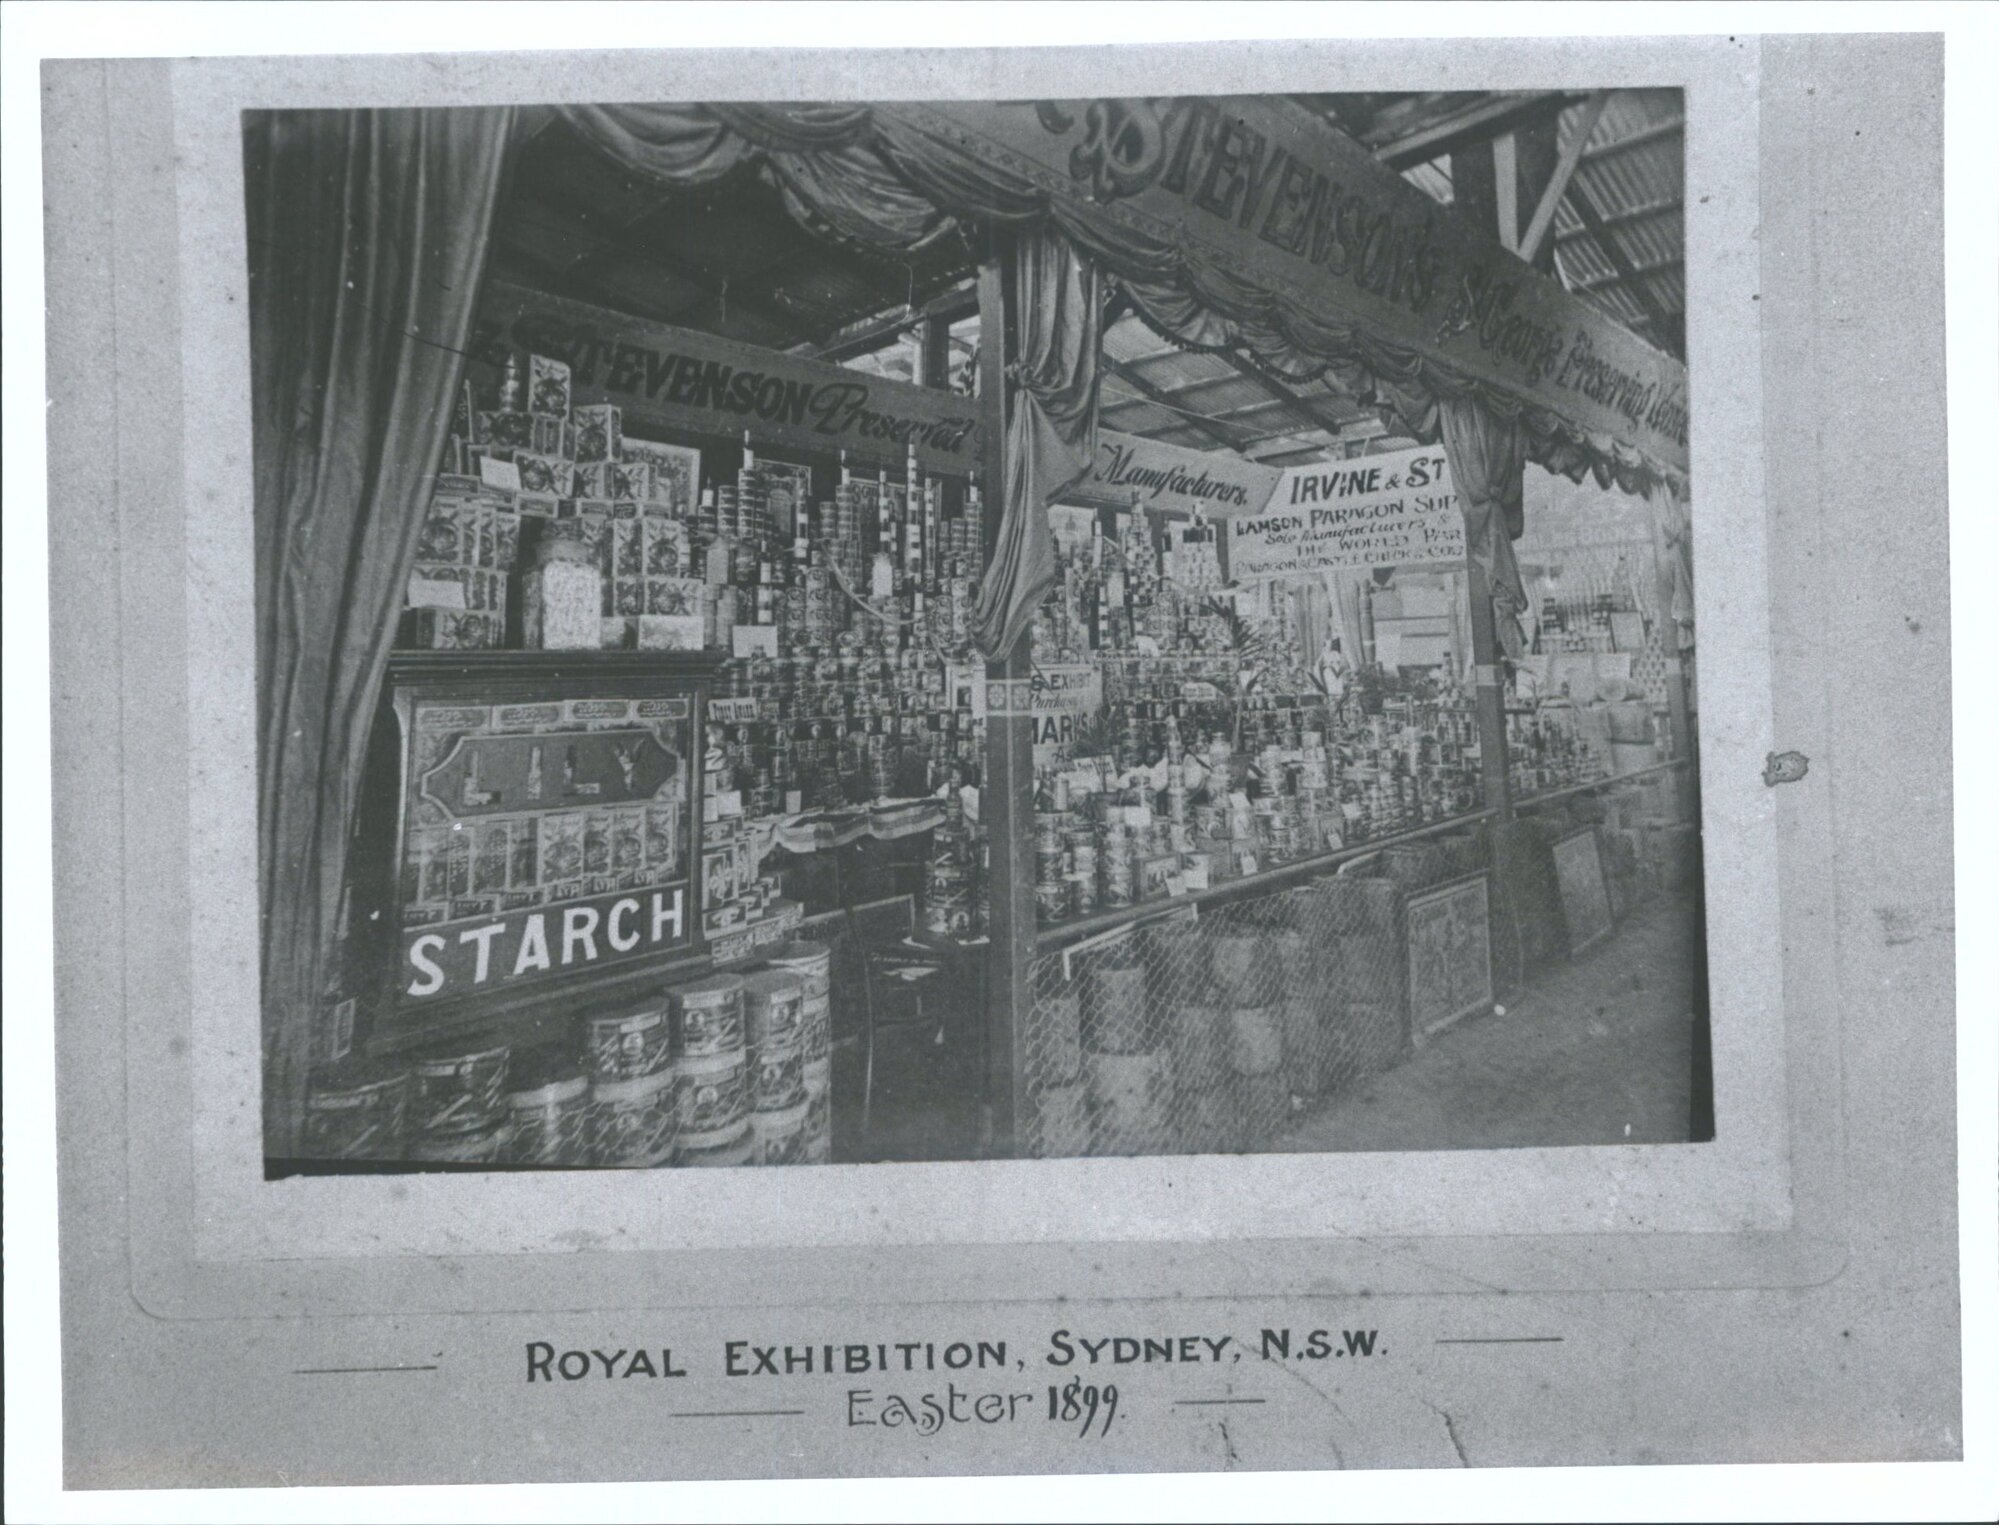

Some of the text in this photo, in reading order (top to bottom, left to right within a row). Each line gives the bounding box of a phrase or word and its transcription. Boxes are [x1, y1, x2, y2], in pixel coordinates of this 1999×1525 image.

[1094, 443, 1248, 506] Manufacturers.
[1290, 466, 1382, 505] IRVINE
[1385, 473, 1402, 491] &
[1236, 515, 1303, 537] LAMSON
[1310, 498, 1405, 529] PARAGON
[464, 738, 647, 806] LILY
[406, 889, 683, 997] STARCH
